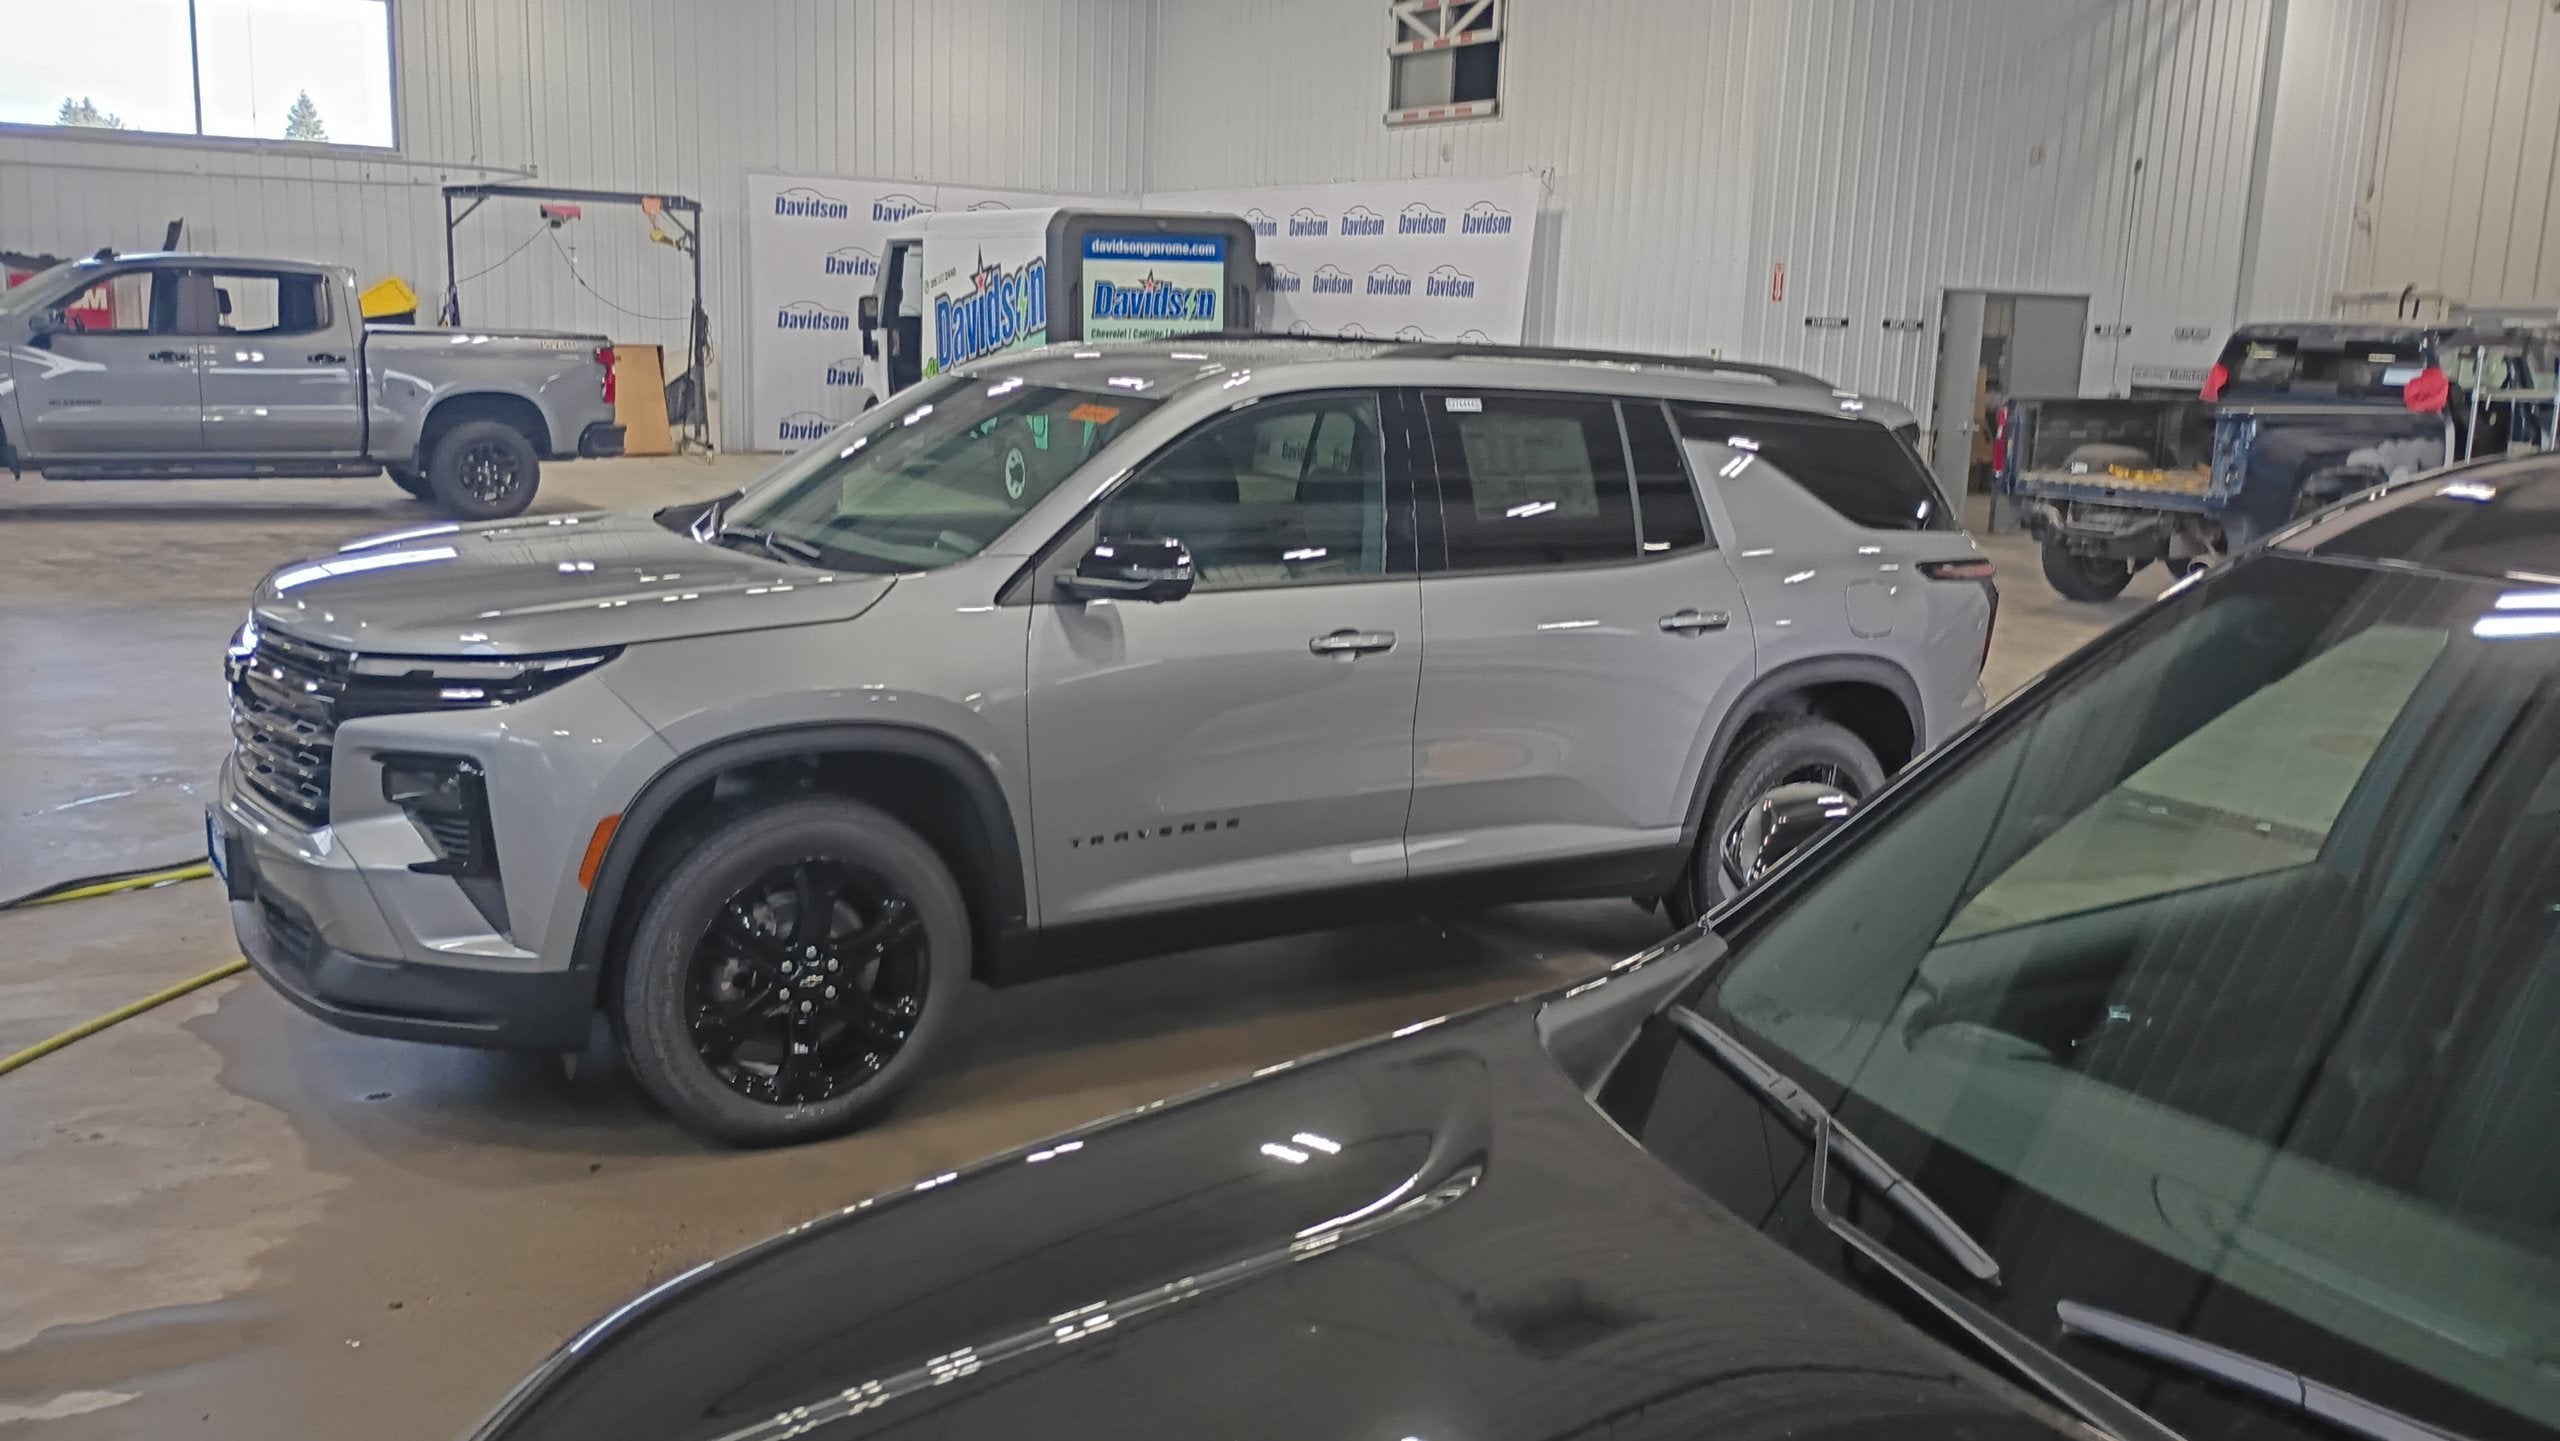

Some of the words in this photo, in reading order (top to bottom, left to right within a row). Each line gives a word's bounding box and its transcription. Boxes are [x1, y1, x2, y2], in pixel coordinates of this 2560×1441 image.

[775, 197, 848, 219] Davidson
[873, 203, 933, 222] David
[1251, 217, 1277, 236] vidson
[1289, 216, 1328, 236] Davidson
[1341, 215, 1385, 235] Davidson
[1399, 212, 1446, 234] Davidson
[1462, 211, 1511, 234] Davidson
[1091, 237, 1216, 257] davidsongmrome.com
[825, 256, 877, 276] Davids
[1313, 273, 1353, 294] Davidson
[1366, 273, 1411, 295] Davidson
[1426, 274, 1475, 298] Davidson
[1092, 278, 1216, 321] Davidson
[778, 310, 849, 330] Davidson
[935, 256, 1046, 372] Davidson
[1091, 328, 1128, 339] Chevrolet
[827, 366, 864, 386] Davi
[1070, 817, 1241, 849] TRAVERSE
